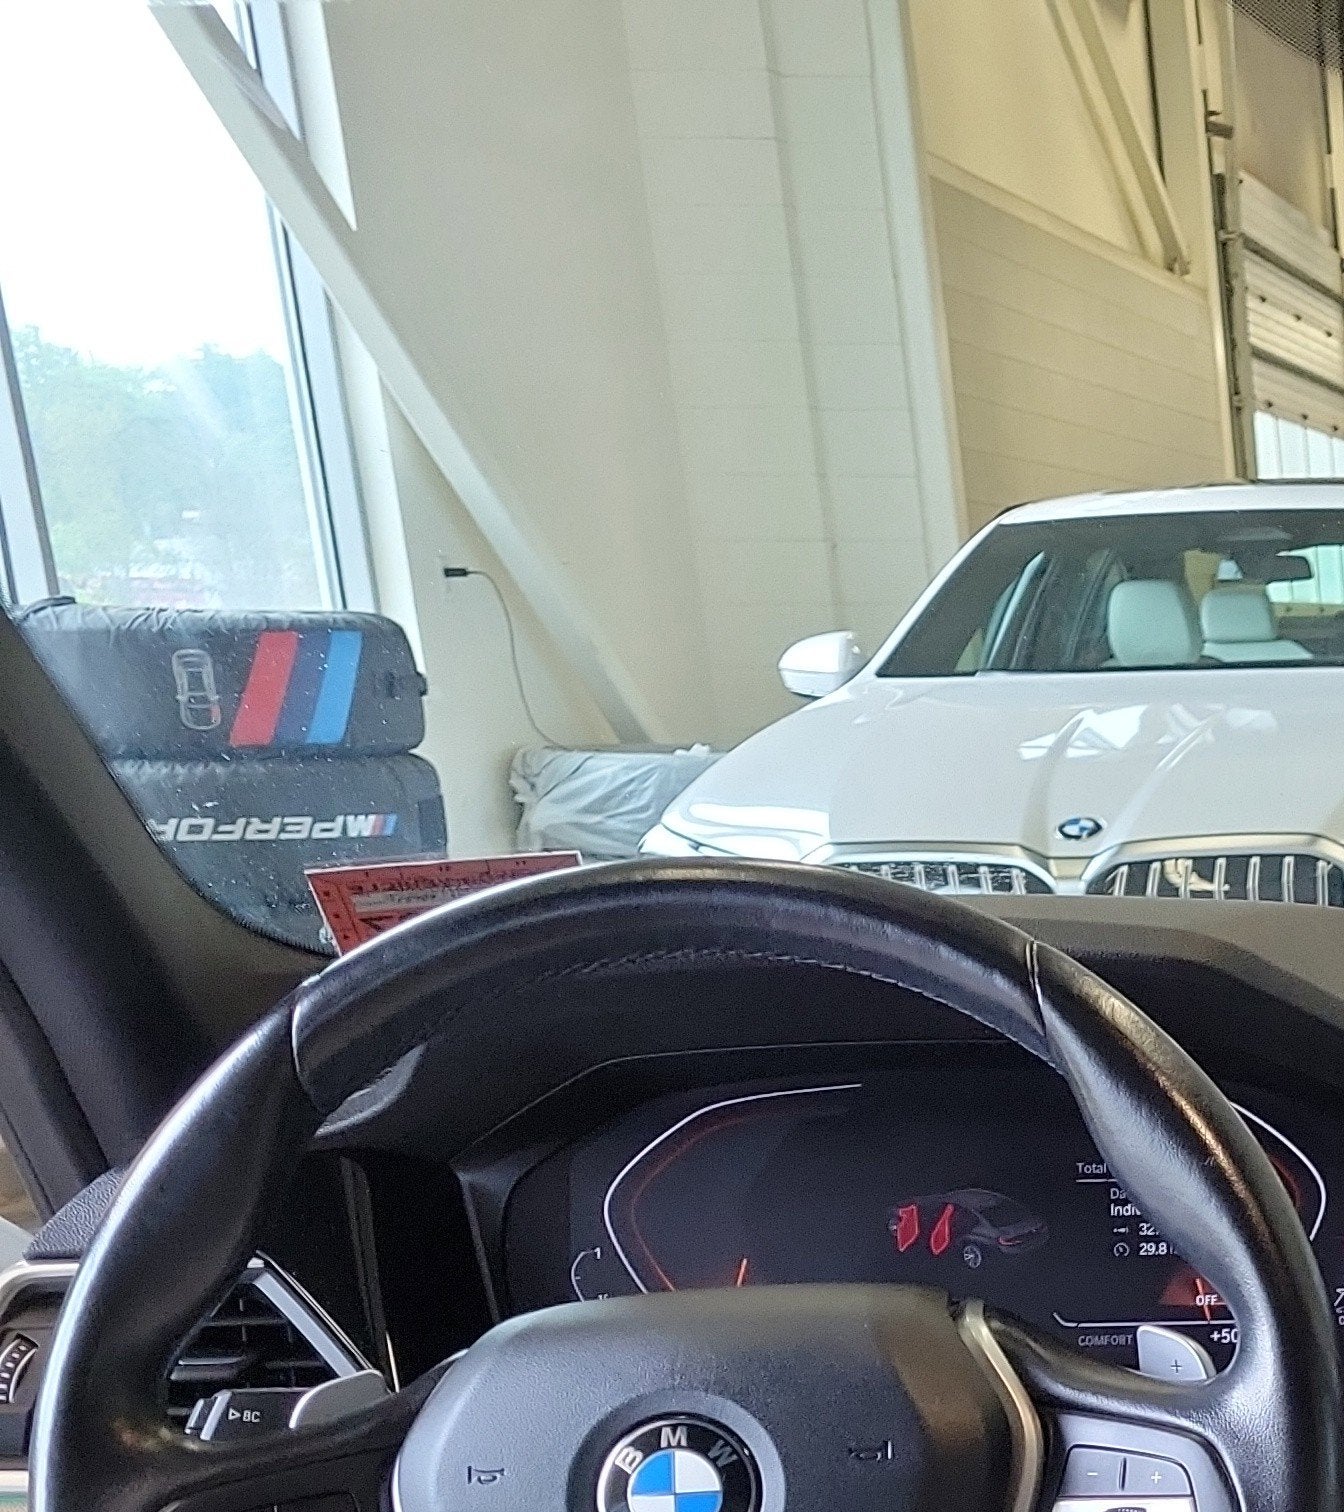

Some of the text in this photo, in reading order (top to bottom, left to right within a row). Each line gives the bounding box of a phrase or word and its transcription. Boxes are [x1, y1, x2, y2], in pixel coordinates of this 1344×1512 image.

[1076, 1162, 1107, 1174] Total
[1138, 1242, 1168, 1256] 29.8
[1195, 1295, 1218, 1306] OFF
[1077, 1333, 1134, 1347] COMFORT
[614, 1425, 738, 1475] BMW
